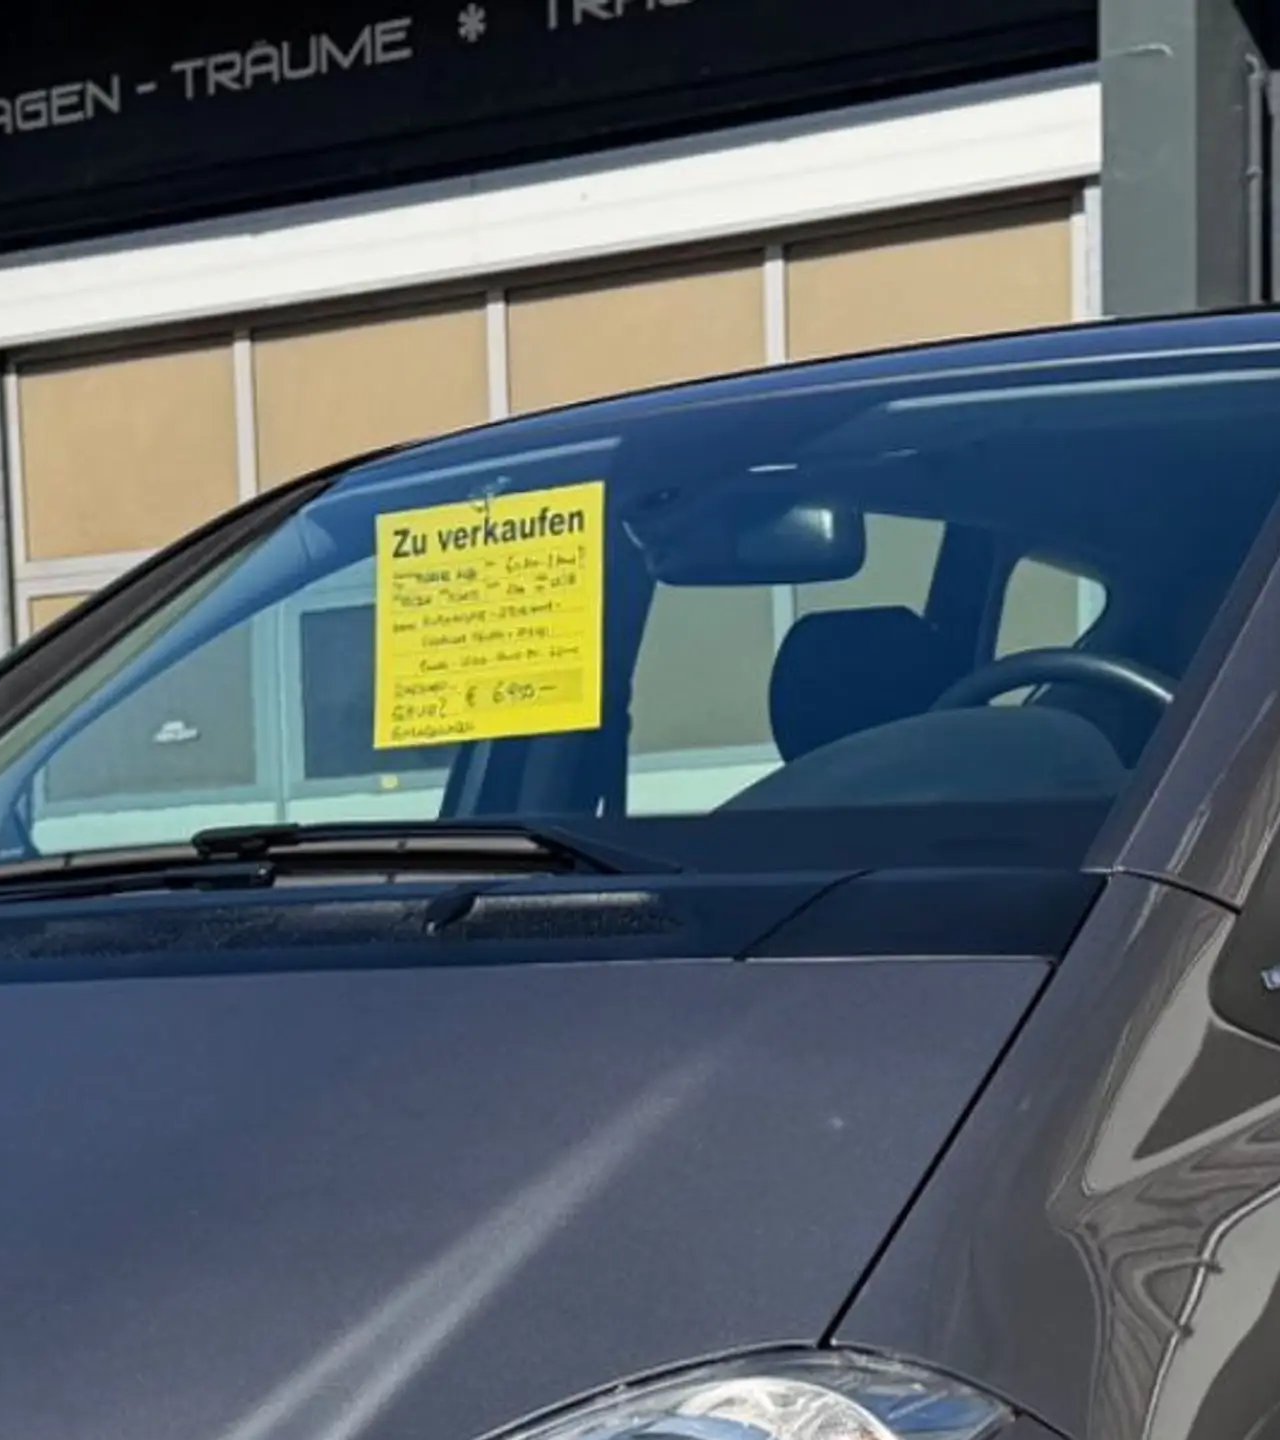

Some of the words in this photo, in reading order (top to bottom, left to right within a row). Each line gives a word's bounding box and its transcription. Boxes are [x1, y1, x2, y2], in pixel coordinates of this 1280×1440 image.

[172, 17, 413, 101] TRÄUME
[392, 529, 427, 559] Zu
[438, 506, 586, 552] verkaufen
